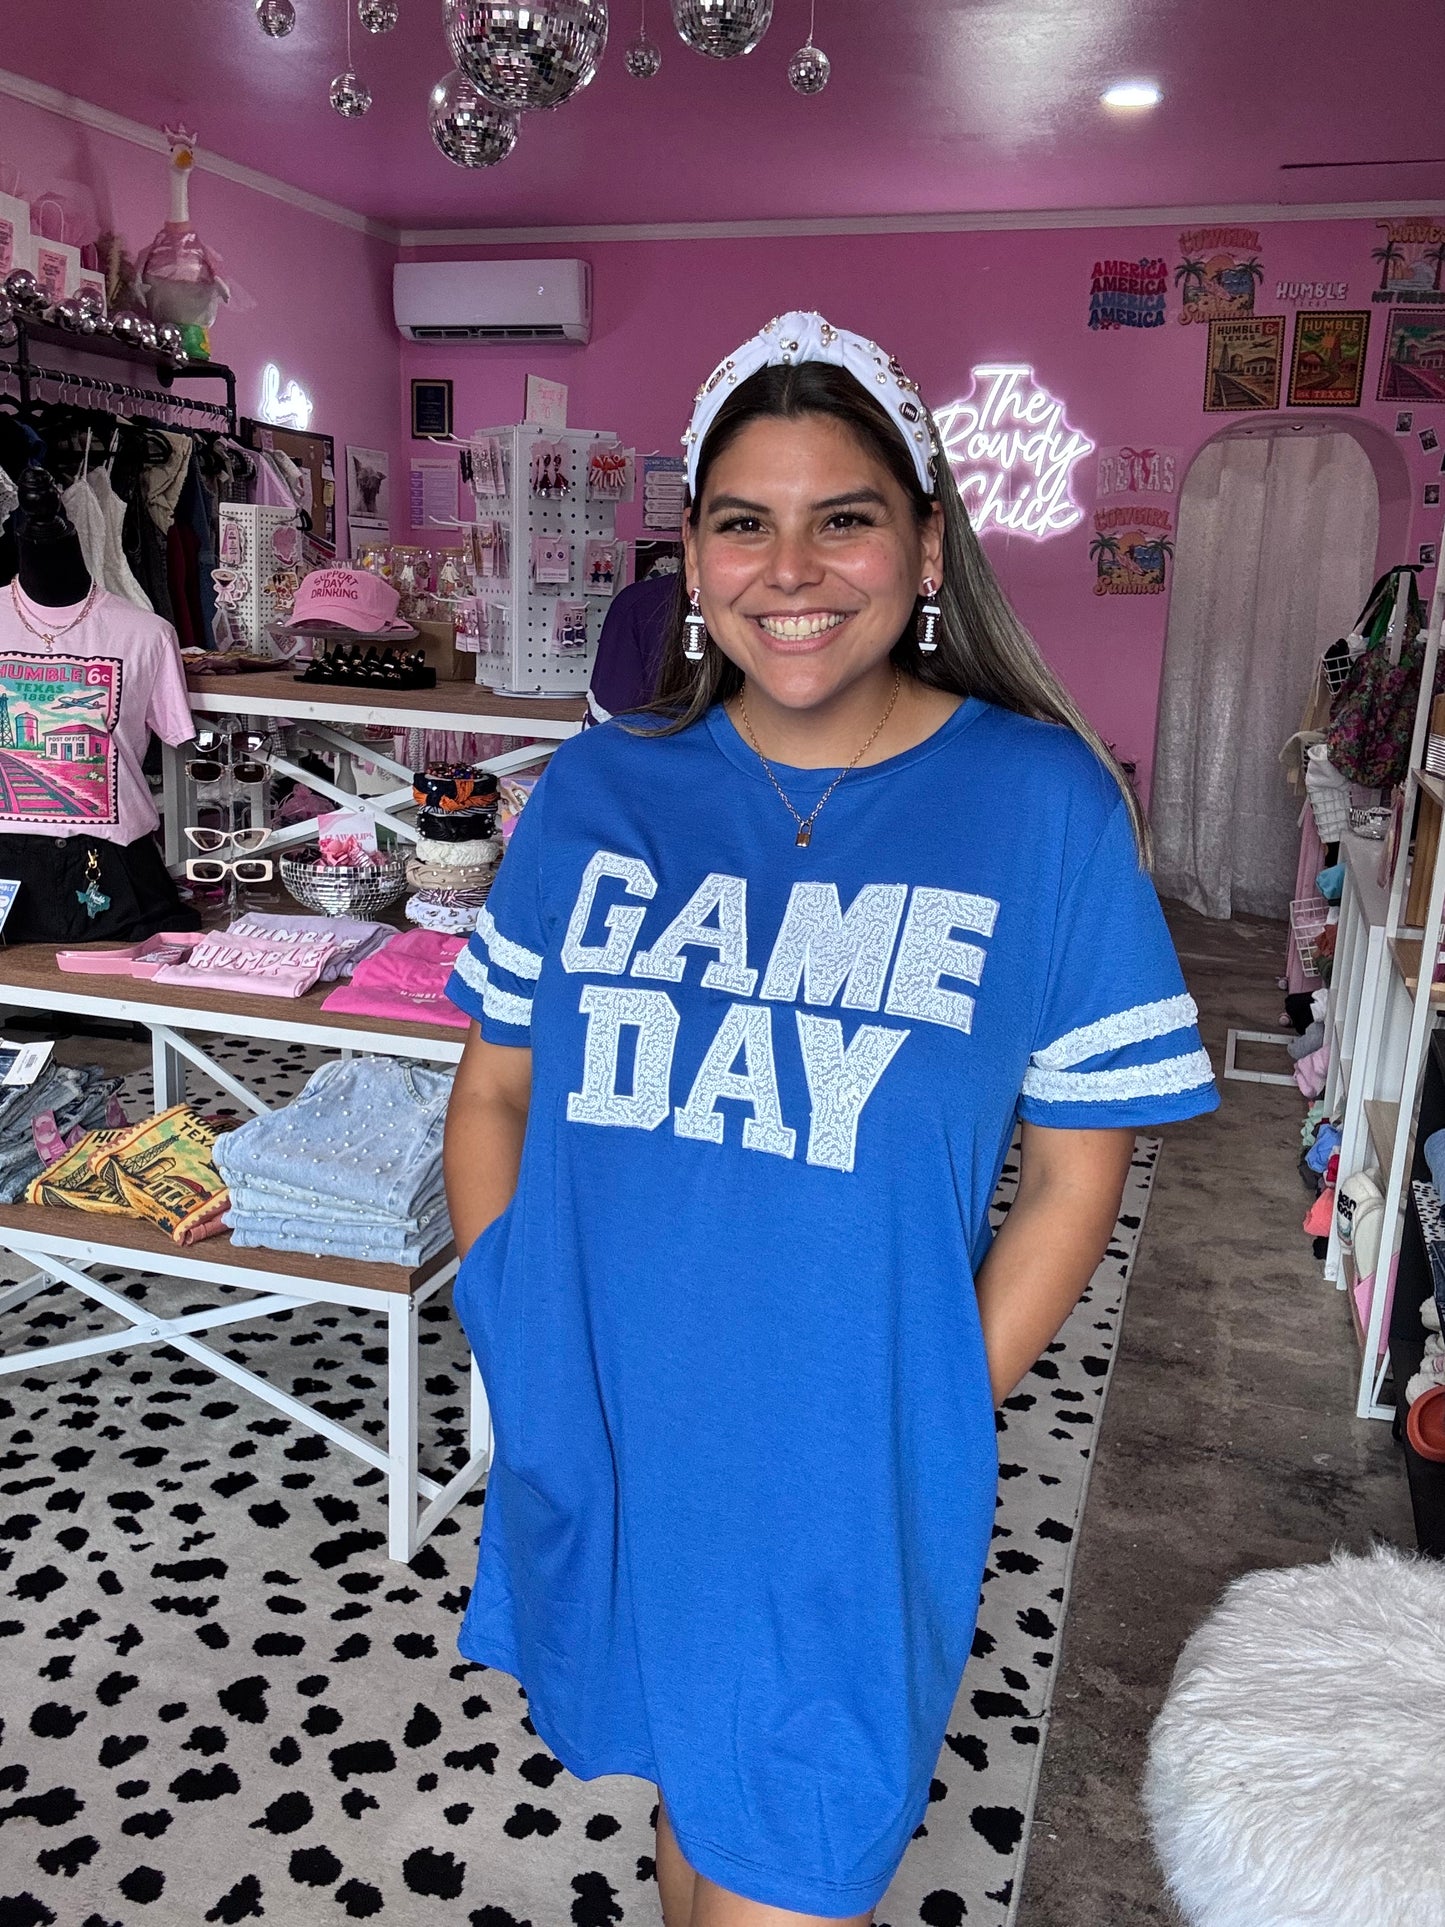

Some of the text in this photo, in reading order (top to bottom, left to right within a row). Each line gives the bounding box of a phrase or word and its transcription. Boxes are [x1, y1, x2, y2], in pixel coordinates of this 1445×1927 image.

[1178, 228, 1263, 255] COWGIRL
[1090, 260, 1169, 279] AMERICA
[1090, 276, 1168, 295] AMERICA
[1275, 281, 1349, 300] HUMBLE
[1089, 292, 1167, 311] AMERICA
[1088, 307, 1166, 328] AMERICA
[1304, 319, 1360, 331] HUMBLE
[1217, 324, 1261, 335] HUMBLE
[1222, 333, 1256, 342] TEXAS
[973, 368, 1052, 431] The
[1314, 389, 1352, 399] TEXAS
[932, 404, 1092, 504] Rowdy
[1100, 454, 1176, 494] TEXAS
[1093, 506, 1173, 531] COWGIRL
[331, 560, 353, 570] SCAN
[314, 570, 359, 587] SUPPORT
[323, 579, 345, 589] DAY
[1093, 575, 1166, 596] Summer
[311, 588, 358, 600] DRINKING
[0, 663, 83, 683] HUMBLE
[15, 682, 65, 694] TEXAS
[23, 693, 56, 702] 1886
[560, 850, 1001, 1034] GAME
[189, 943, 326, 971] HUMBLE
[566, 984, 912, 1172] DAY
